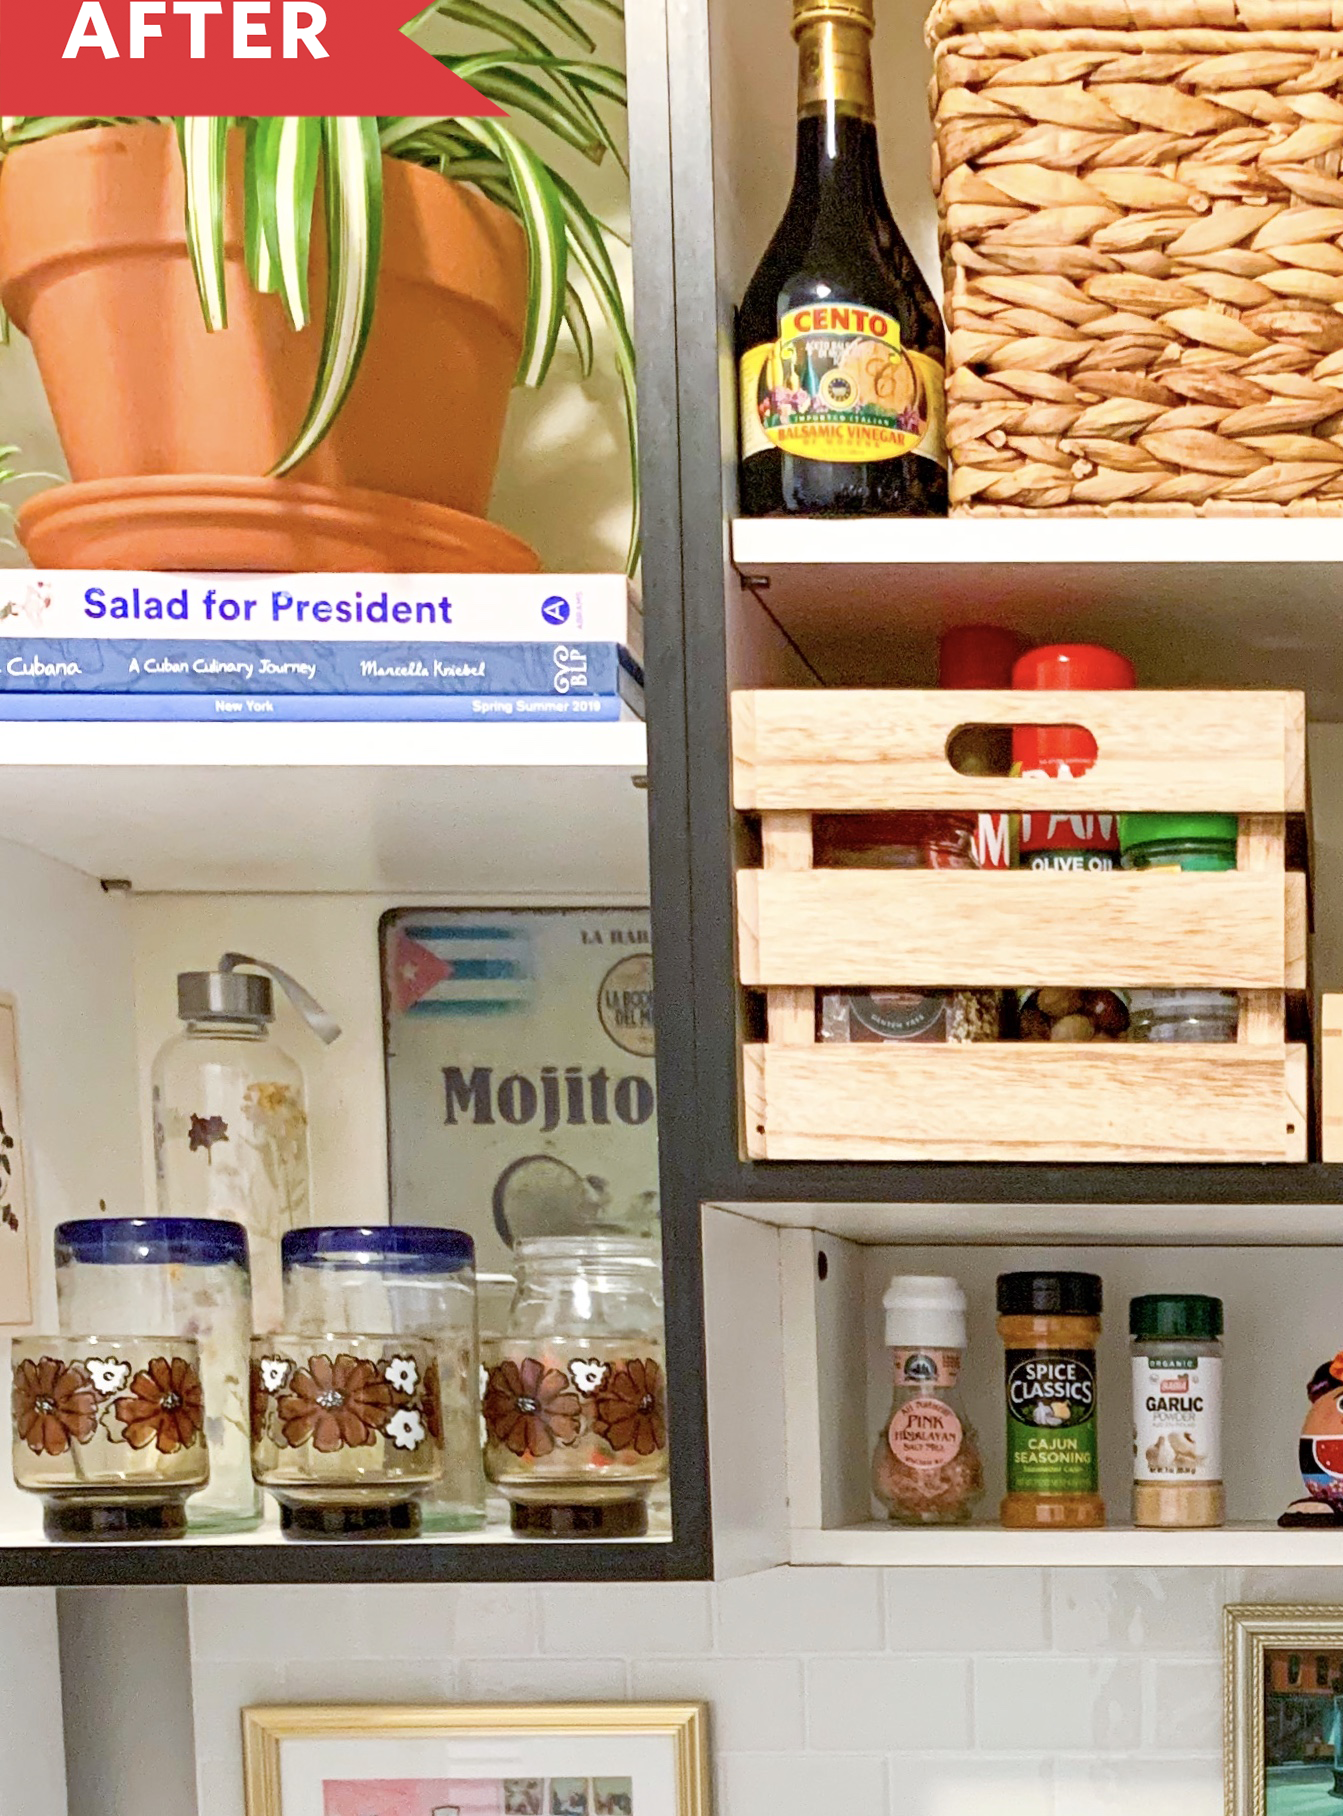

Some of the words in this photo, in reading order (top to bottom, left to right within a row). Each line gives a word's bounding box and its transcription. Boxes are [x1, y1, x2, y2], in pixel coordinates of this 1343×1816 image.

[794, 307, 888, 337] CENTO
[850, 415, 890, 426] ITALIAN
[778, 426, 844, 440] BALSAMIC
[850, 426, 905, 446] VINEGAR
[84, 587, 188, 619] Salad
[202, 590, 257, 621] for
[272, 590, 453, 624] President
[7, 655, 82, 676] Cubana
[129, 658, 140, 674] A
[144, 658, 188, 673] Cuban
[193, 659, 253, 678] Culinary
[258, 659, 316, 679] Journey
[360, 660, 428, 677] Marcella
[571, 649, 587, 687] BLP
[215, 701, 242, 712] New
[246, 700, 273, 712] York
[472, 700, 513, 714] Spring
[516, 701, 568, 712] Summer
[1032, 856, 1084, 871] OLIVE
[442, 1066, 654, 1132] Mojito
[1026, 1364, 1077, 1380] SPICE
[1011, 1380, 1092, 1403] CLASSICS
[1146, 1397, 1203, 1412] GARLIC
[906, 1415, 944, 1429] PINK
[1153, 1412, 1196, 1421] POWDER
[1028, 1439, 1078, 1450] CAJUN
[1015, 1451, 1091, 1464] SEASONING
